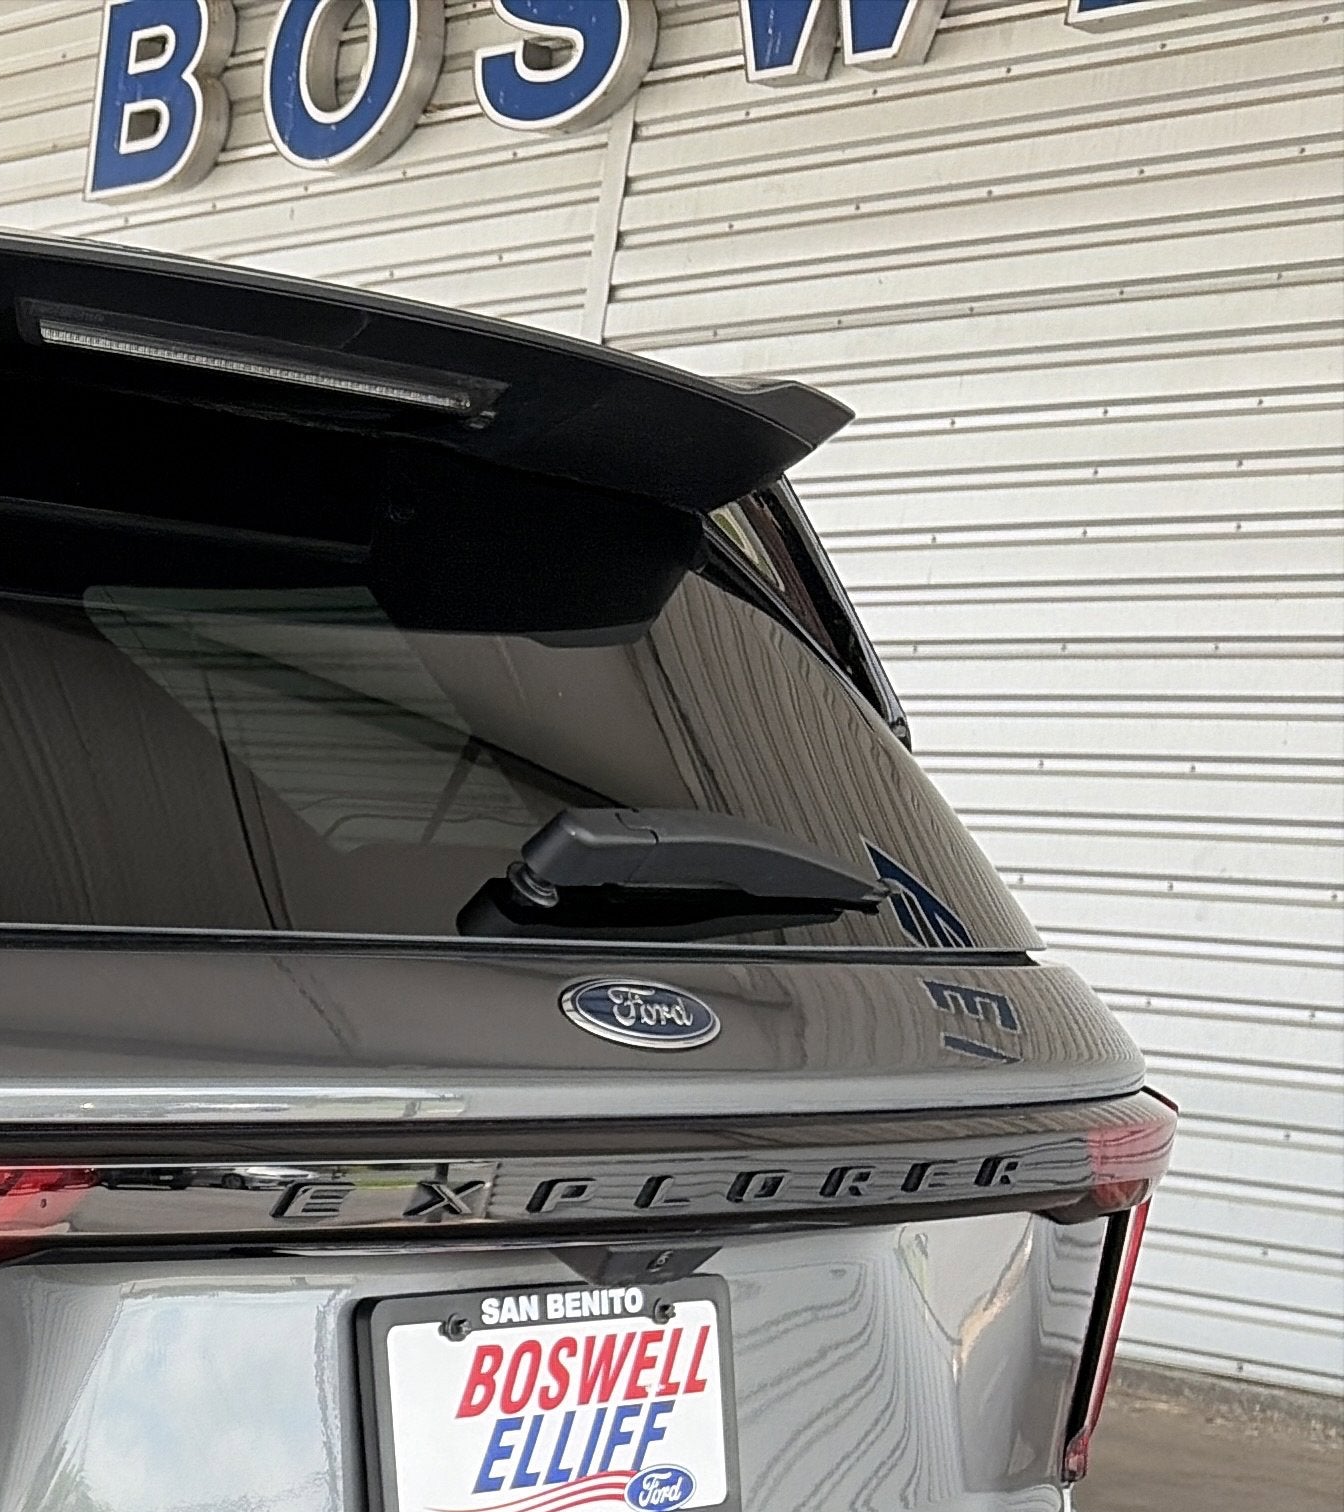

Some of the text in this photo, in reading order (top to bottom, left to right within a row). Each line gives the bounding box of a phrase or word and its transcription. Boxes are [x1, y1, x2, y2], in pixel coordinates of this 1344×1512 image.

[611, 986, 693, 1028] Ford
[269, 1154, 1028, 1219] EXPLORER
[481, 1287, 644, 1325] SAN BENITO
[456, 1325, 710, 1418] BOSWELL
[471, 1399, 676, 1495] ELLIFF
[637, 1472, 683, 1509] Ford
